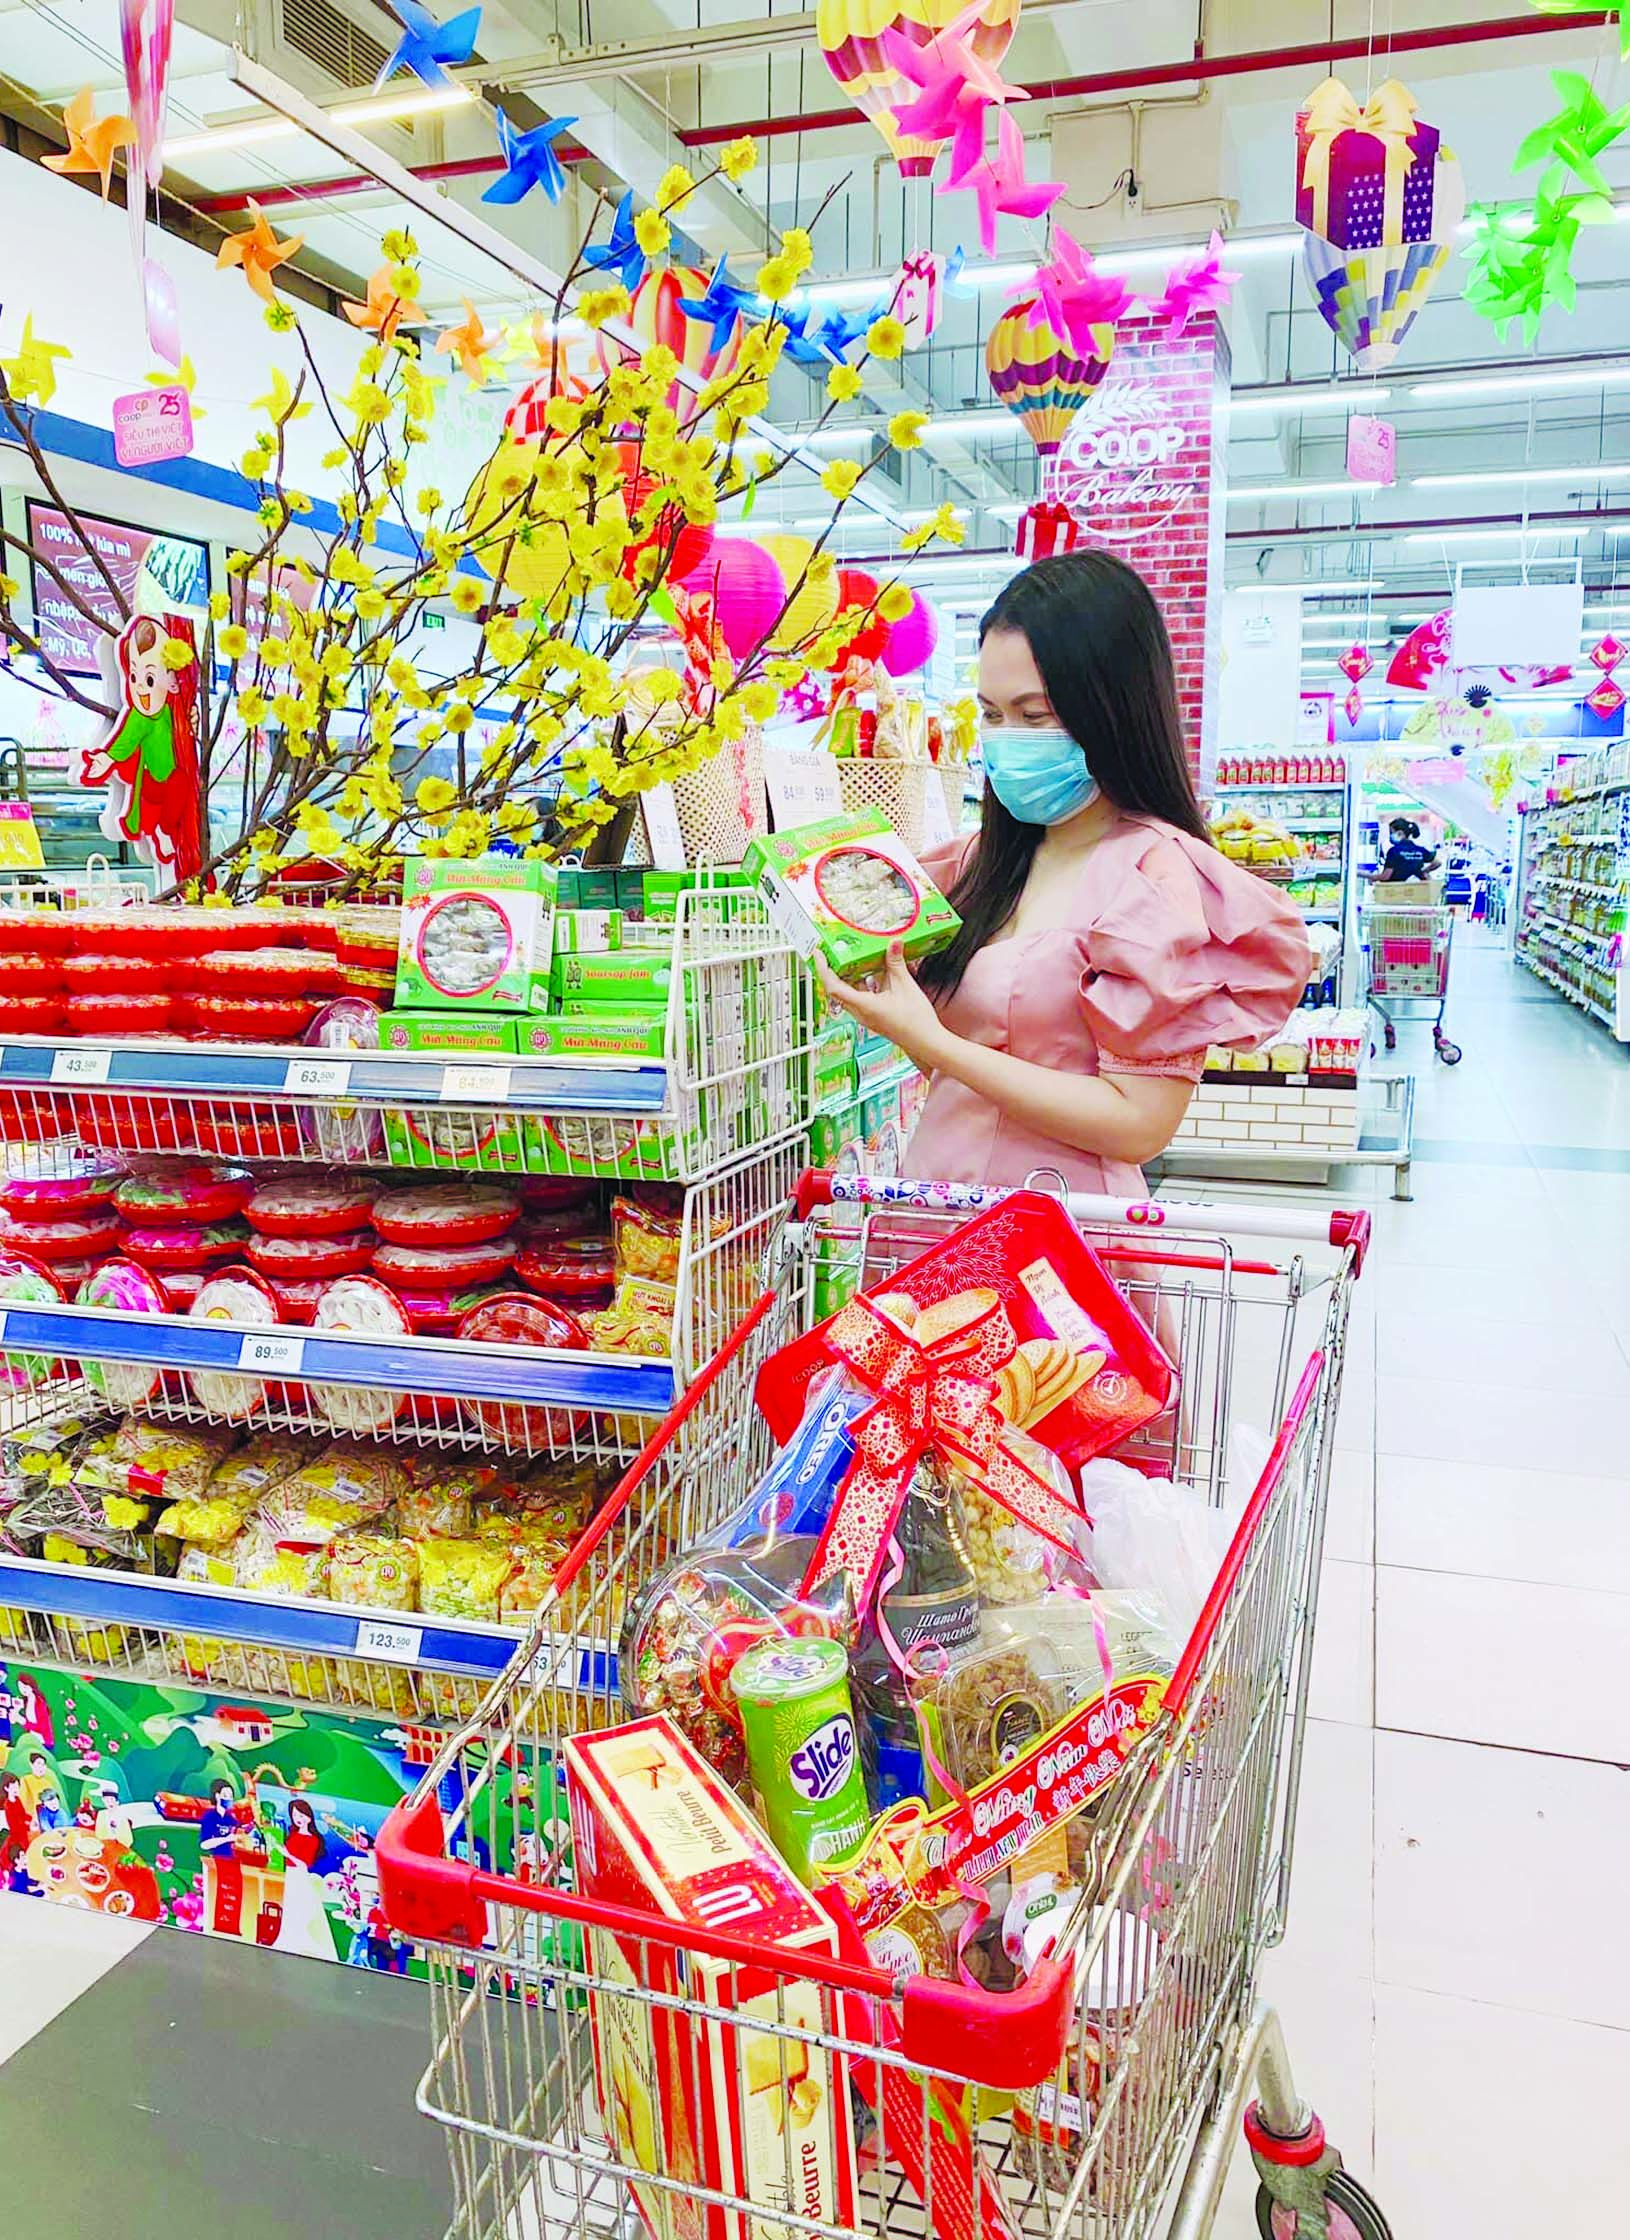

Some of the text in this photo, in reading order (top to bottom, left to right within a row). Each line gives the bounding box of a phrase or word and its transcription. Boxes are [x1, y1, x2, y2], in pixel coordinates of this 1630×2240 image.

[159, 392, 180, 416] 25
[1060, 467, 1195, 510] Bakery
[39, 522, 74, 545] 100%
[255, 1345, 288, 1359] 89.500
[795, 1401, 847, 1485] OREO
[369, 1632, 412, 1648] 123.500
[790, 1727, 851, 1799] Slide
[676, 1790, 711, 1829] Beurre
[692, 1883, 764, 1929] LU
[801, 2140, 823, 2219] Beurre
